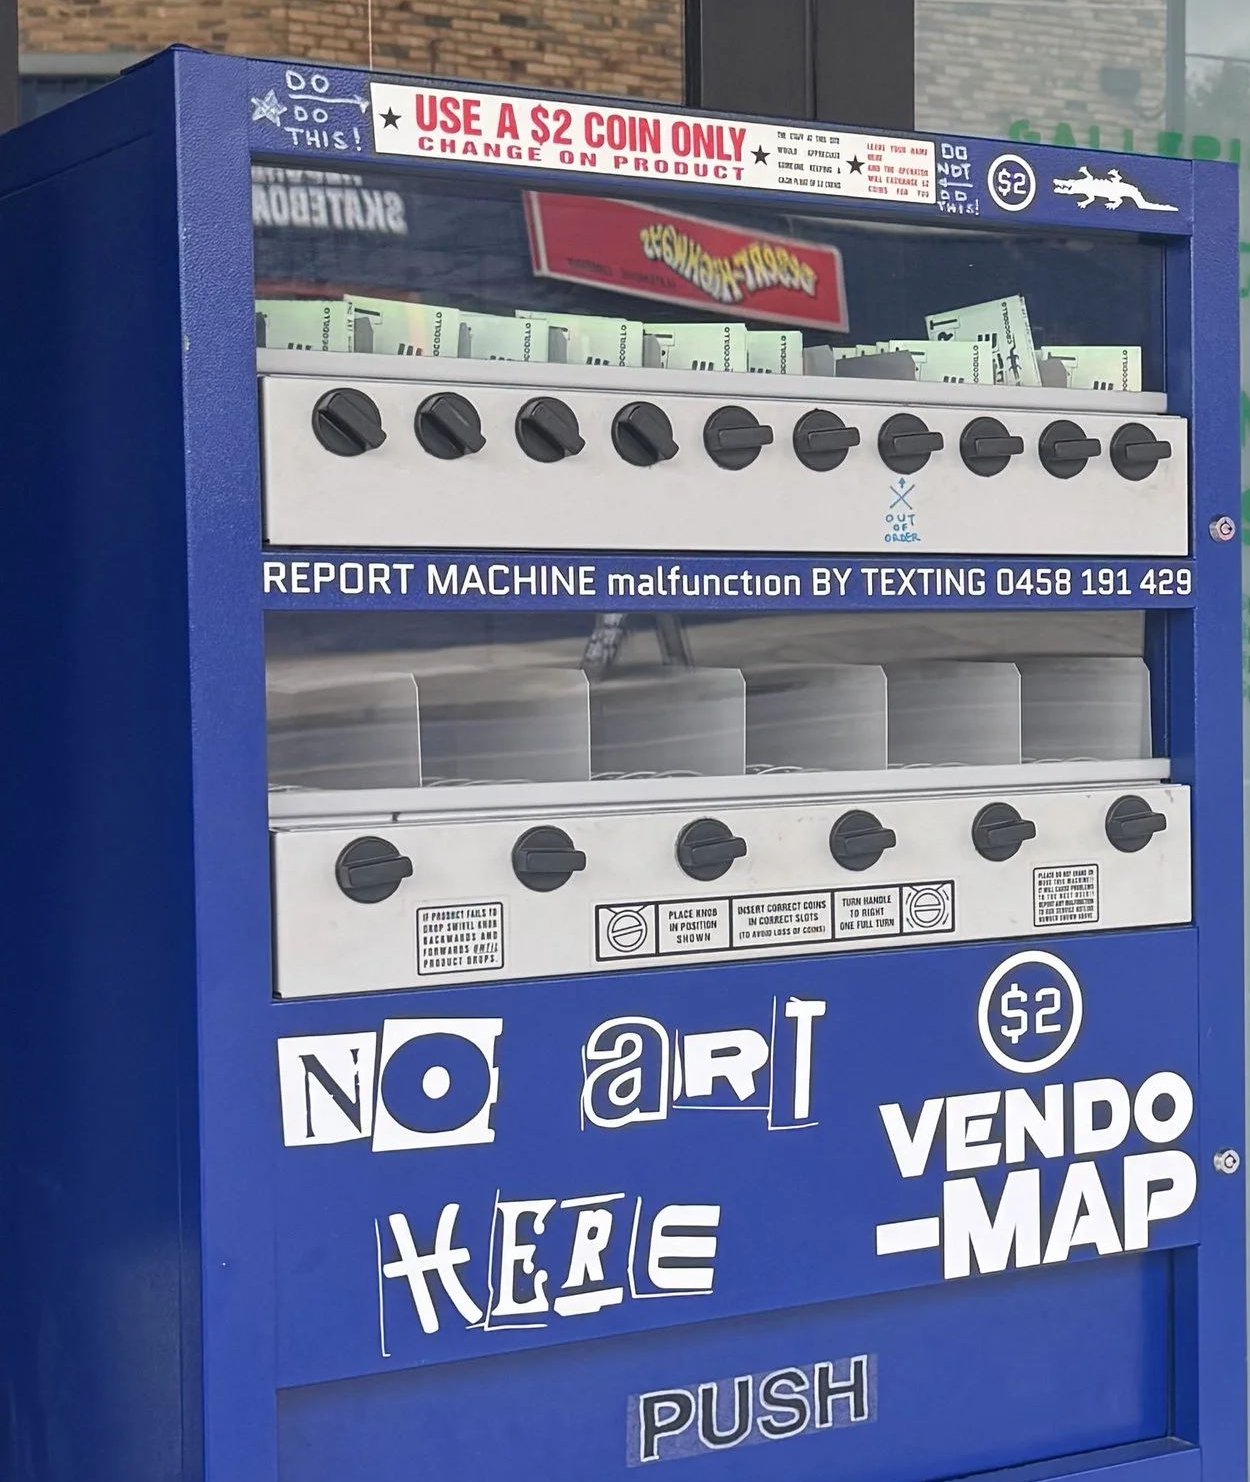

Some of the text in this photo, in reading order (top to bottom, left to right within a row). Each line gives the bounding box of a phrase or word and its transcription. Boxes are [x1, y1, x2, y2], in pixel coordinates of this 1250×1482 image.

[286, 71, 329, 93] DO
[294, 106, 328, 123] DO
[416, 94, 481, 135] USE
[497, 103, 519, 139] A
[531, 104, 572, 146] $2
[585, 112, 661, 155] COIN
[672, 119, 746, 162] ONLY
[285, 127, 362, 152] THIS!
[418, 136, 744, 180] CHANGE ON PRODUCT
[941, 143, 968, 160] DO
[938, 163, 970, 180] NOT
[998, 169, 1026, 195] $2
[941, 189, 968, 202] DO
[937, 199, 980, 216] THIS!
[886, 514, 915, 526] OUT
[893, 522, 908, 532] OF
[884, 531, 921, 543] ORDER
[263, 562, 1192, 596] REPORT MACHINE malfunction BY TEXTING 0458 191 429
[738, 900, 826, 914] INSERT CORRECT COINS
[842, 895, 891, 906] TURN HANDLE
[669, 908, 717, 919] PLACE KNOB
[749, 913, 818, 925] IN CORRECT SLOTS
[850, 907, 884, 918] TO RIGHT
[670, 920, 717, 931] IN POSITION
[774, 928, 790, 936] LOSS
[840, 918, 894, 930] ONE FULL TURN
[677, 932, 711, 943] SHOWN
[1001, 983, 1061, 1044] $2
[277, 1017, 503, 1152] NO
[878, 1071, 1194, 1178] VENDO
[383, 1191, 722, 1334] HERE
[640, 1354, 868, 1462] PUSH
